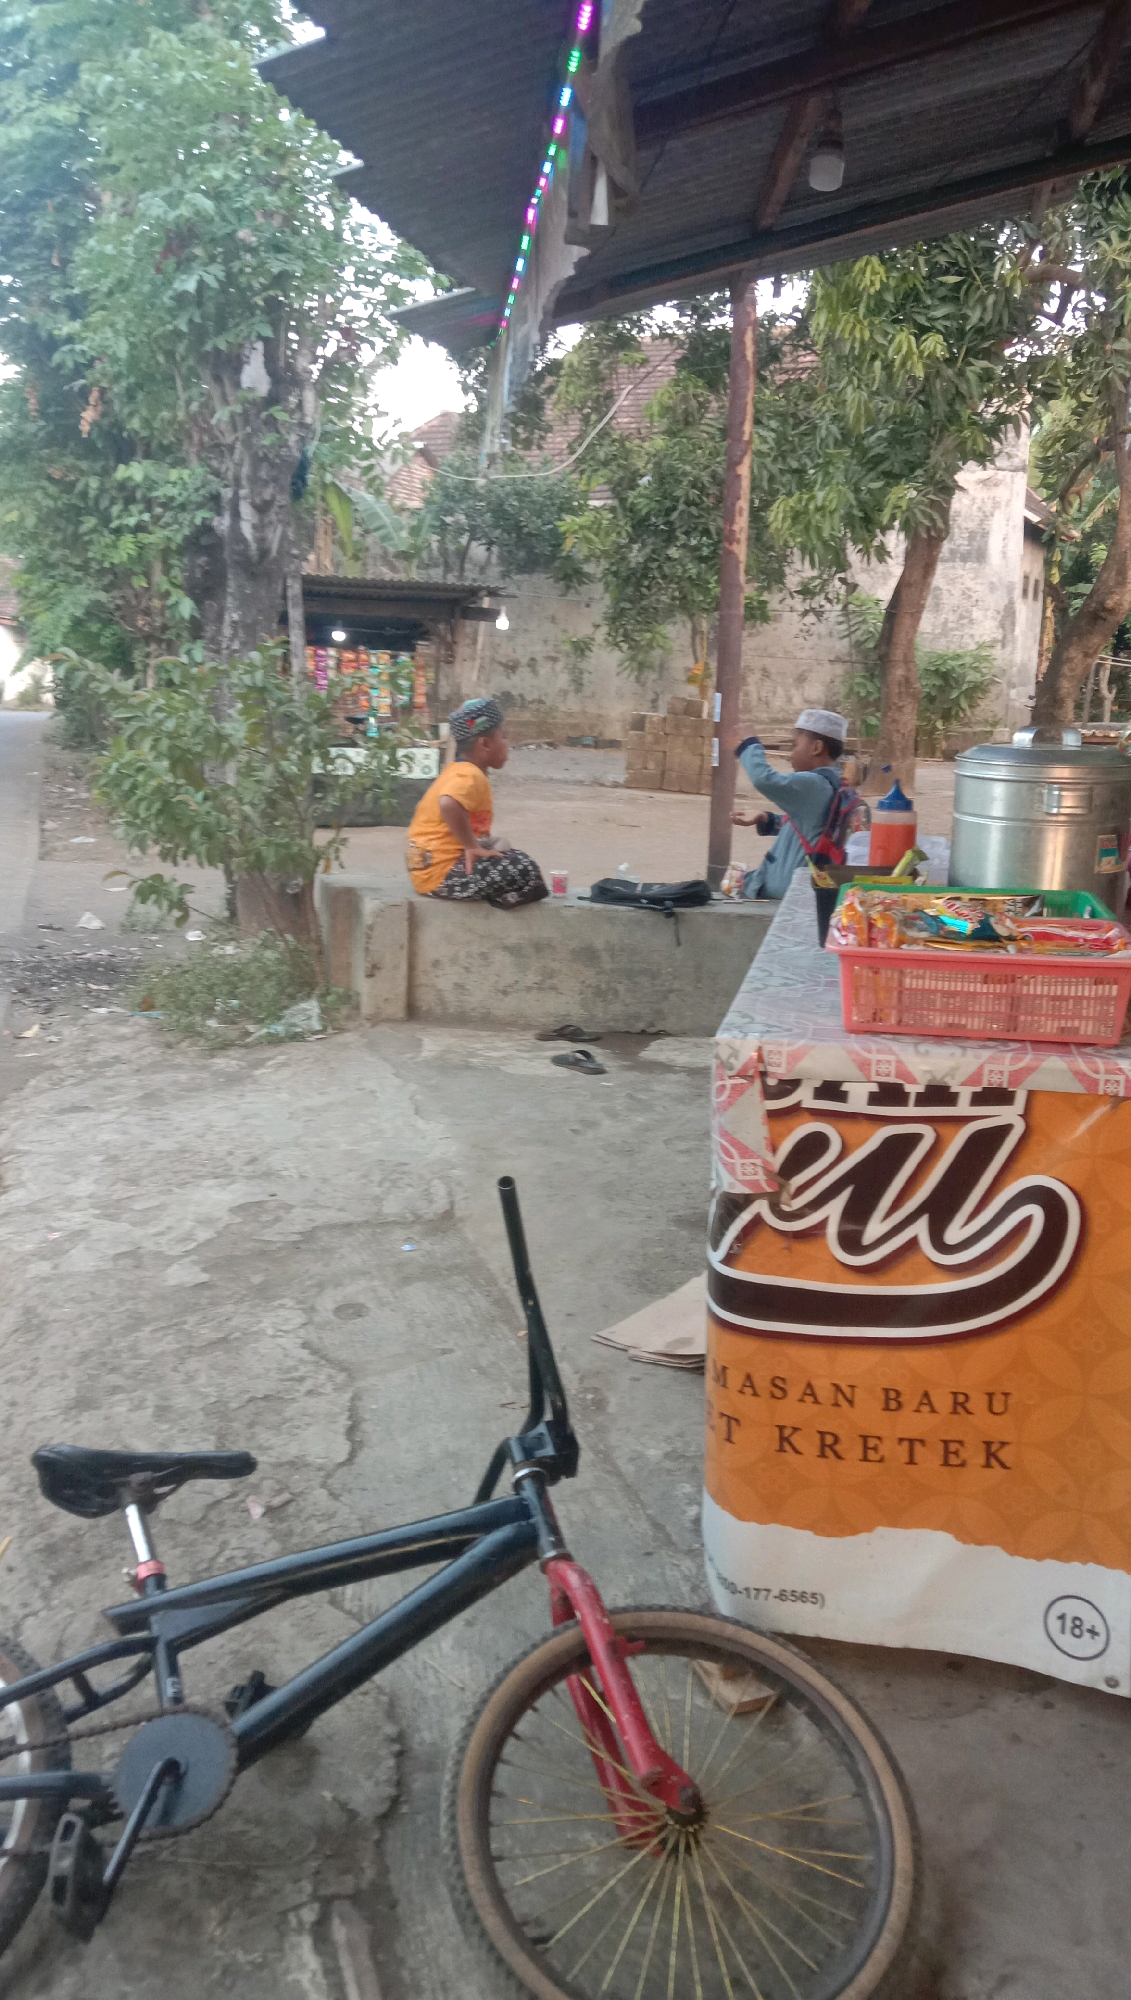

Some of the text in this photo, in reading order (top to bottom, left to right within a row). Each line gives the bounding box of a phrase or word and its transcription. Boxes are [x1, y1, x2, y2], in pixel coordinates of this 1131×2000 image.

[882, 1387, 1012, 1416] BARU
[775, 1424, 1012, 1470] KRETEK
[1056, 1611, 1101, 1642] 18+
